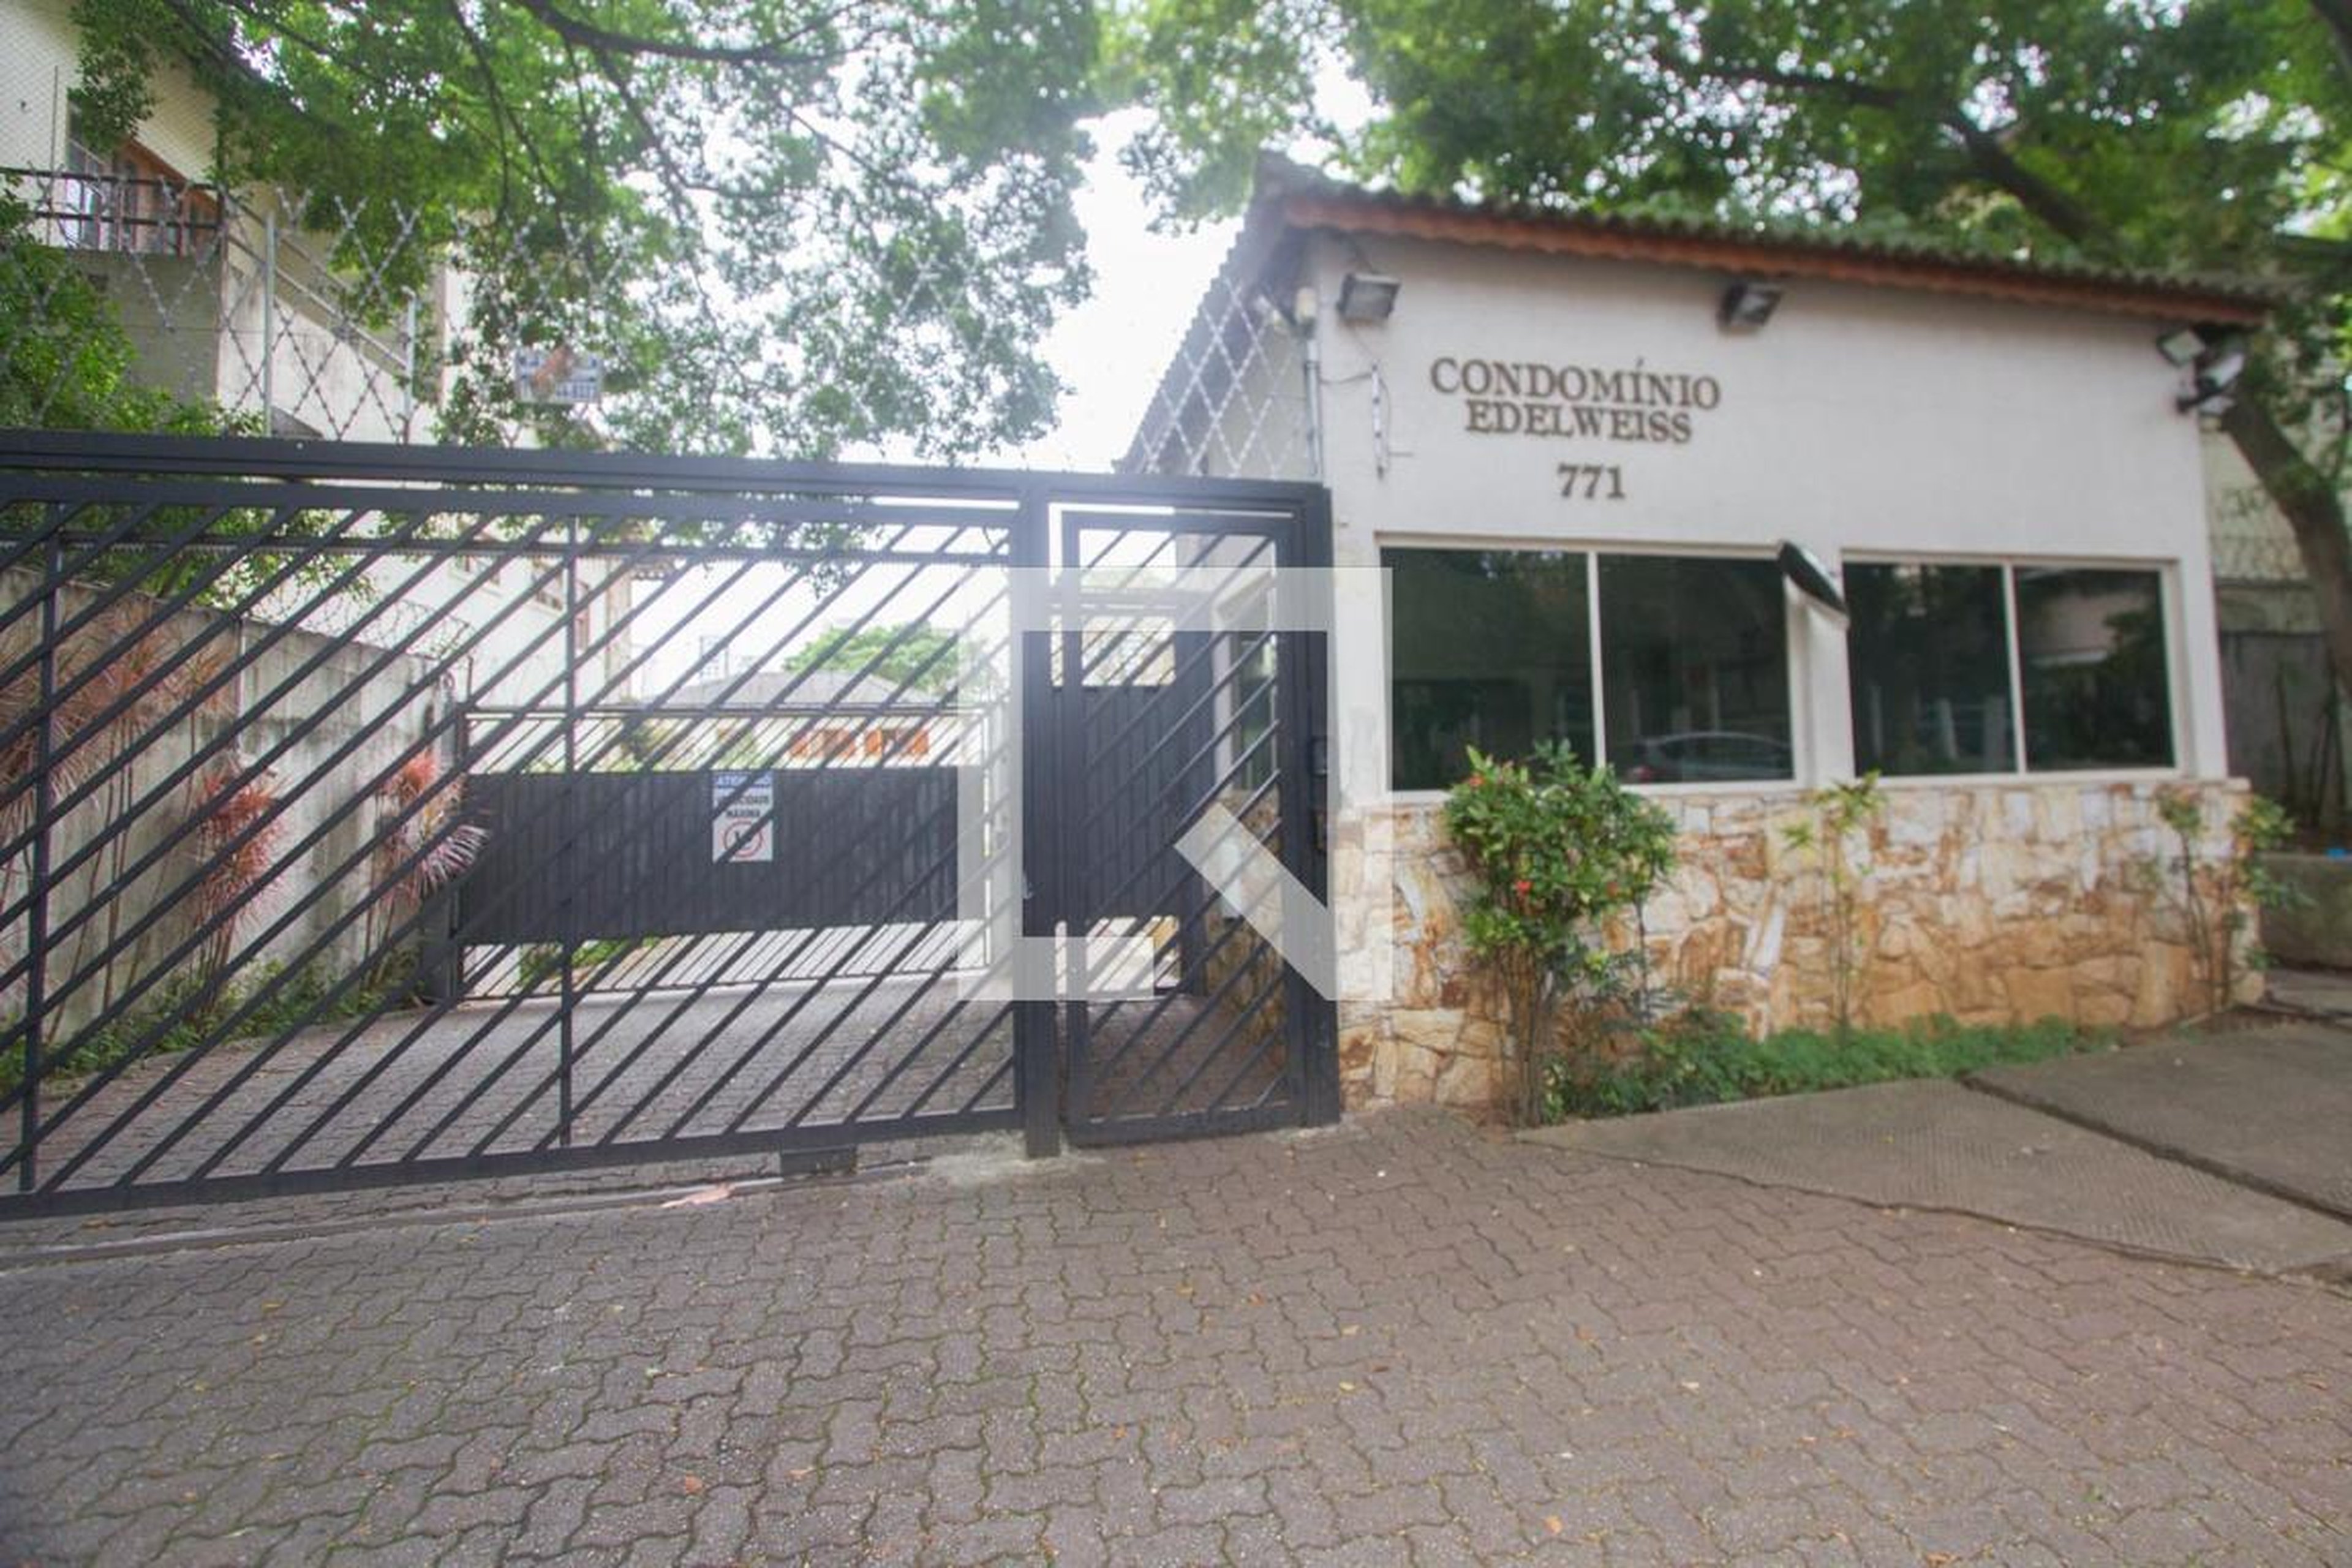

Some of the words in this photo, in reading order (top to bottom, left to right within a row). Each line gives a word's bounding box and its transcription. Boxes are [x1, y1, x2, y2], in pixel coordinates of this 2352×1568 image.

[1430, 356, 1721, 410] CONDOMÍNIO
[1466, 400, 1692, 444] EDELWEISS
[1557, 463, 1626, 500] 771
